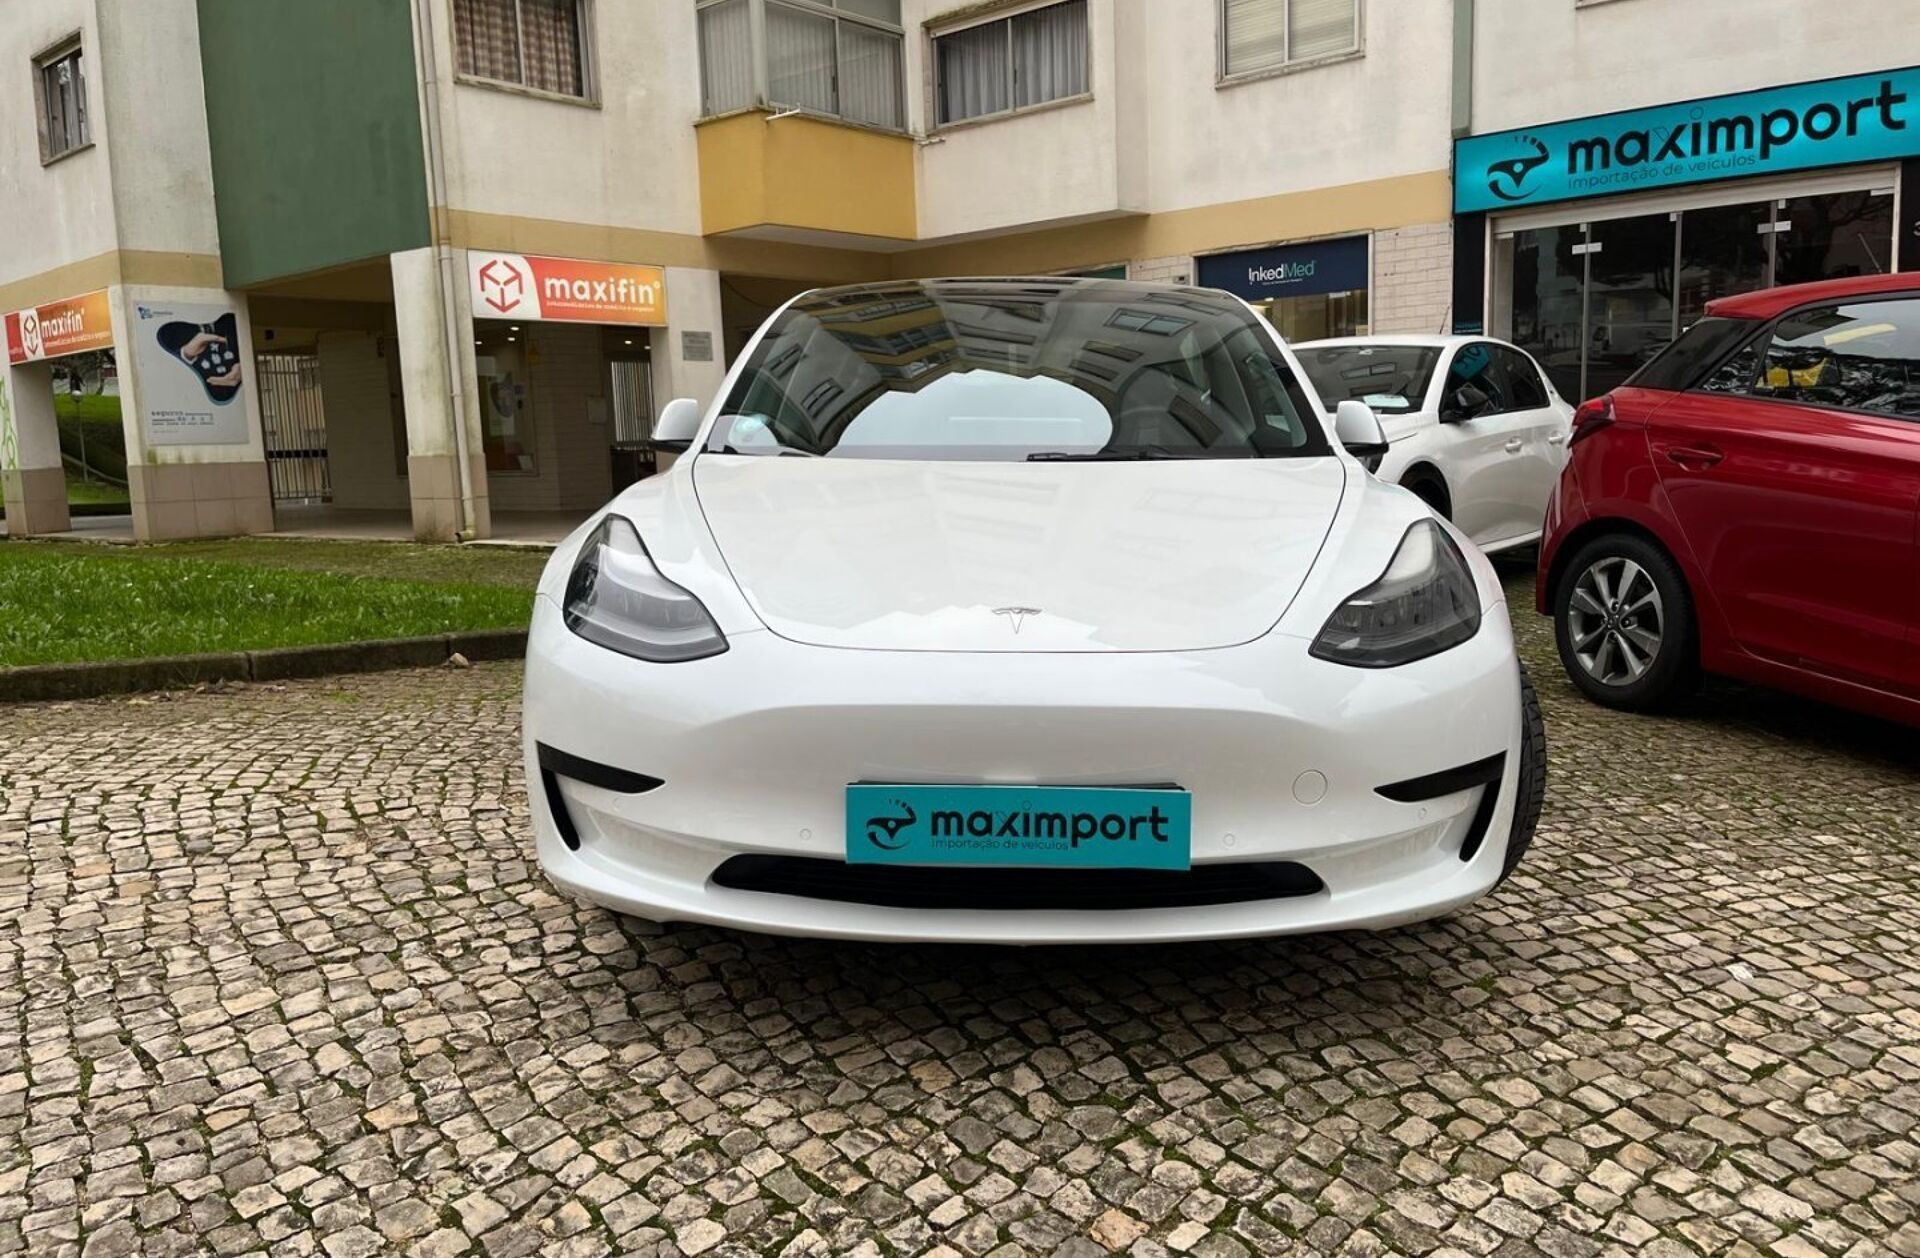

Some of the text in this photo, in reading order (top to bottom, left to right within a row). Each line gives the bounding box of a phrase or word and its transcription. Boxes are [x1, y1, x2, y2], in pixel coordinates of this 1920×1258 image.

[1567, 80, 1907, 174] maximport
[1568, 163, 1658, 190] importação
[1663, 162, 1684, 177] de
[1248, 260, 1315, 282] InkedMed
[931, 804, 1169, 848] maximport
[1003, 839, 1018, 849] de
